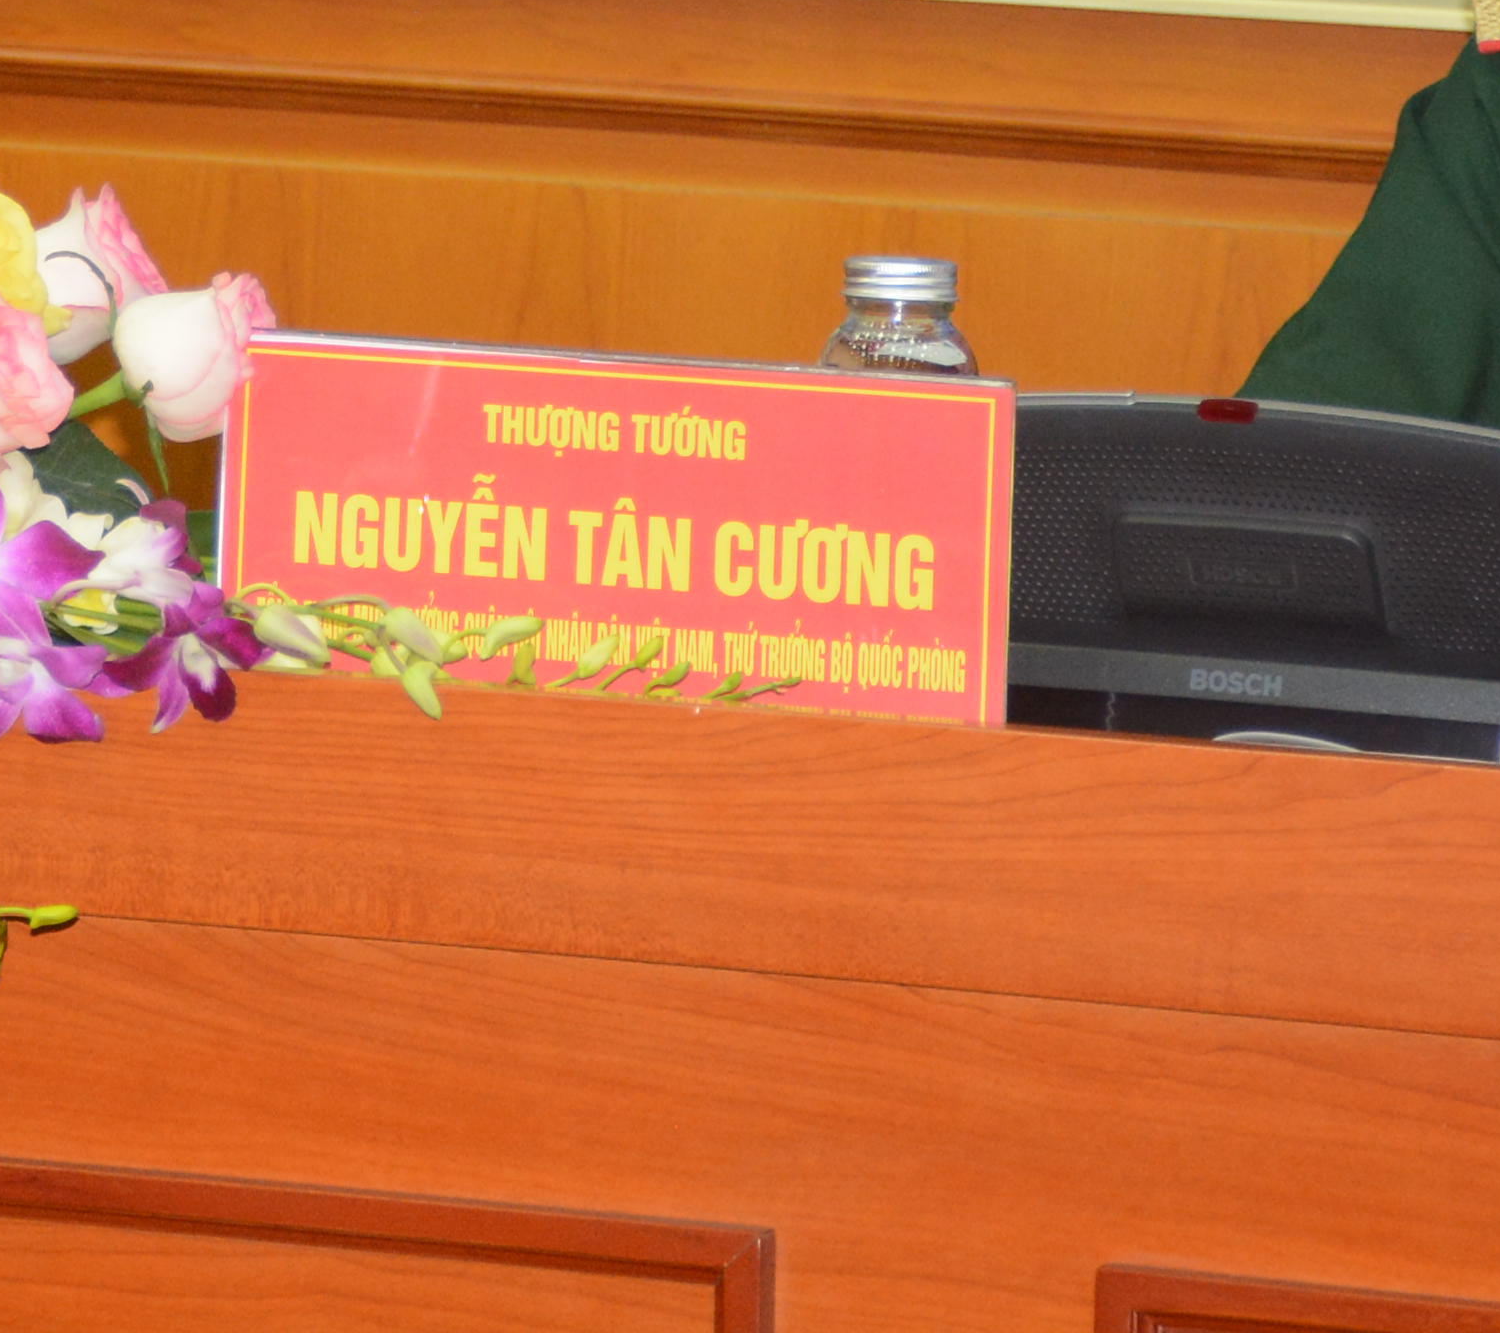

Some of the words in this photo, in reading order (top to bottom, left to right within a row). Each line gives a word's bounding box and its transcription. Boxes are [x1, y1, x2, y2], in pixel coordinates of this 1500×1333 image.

[483, 403, 620, 458] THƯỢNG
[631, 406, 746, 461] TƯỚNG
[293, 473, 548, 581] NGUYỄN
[568, 498, 691, 592] TÂN
[713, 517, 934, 611] CƯƠNG
[723, 621, 757, 676] THỨ
[760, 618, 826, 682] TRƯỞNG
[830, 632, 854, 694] BỘ
[857, 628, 903, 690] QUỐC
[907, 638, 966, 694] PHÒNG
[1190, 668, 1283, 697] BOSCH
